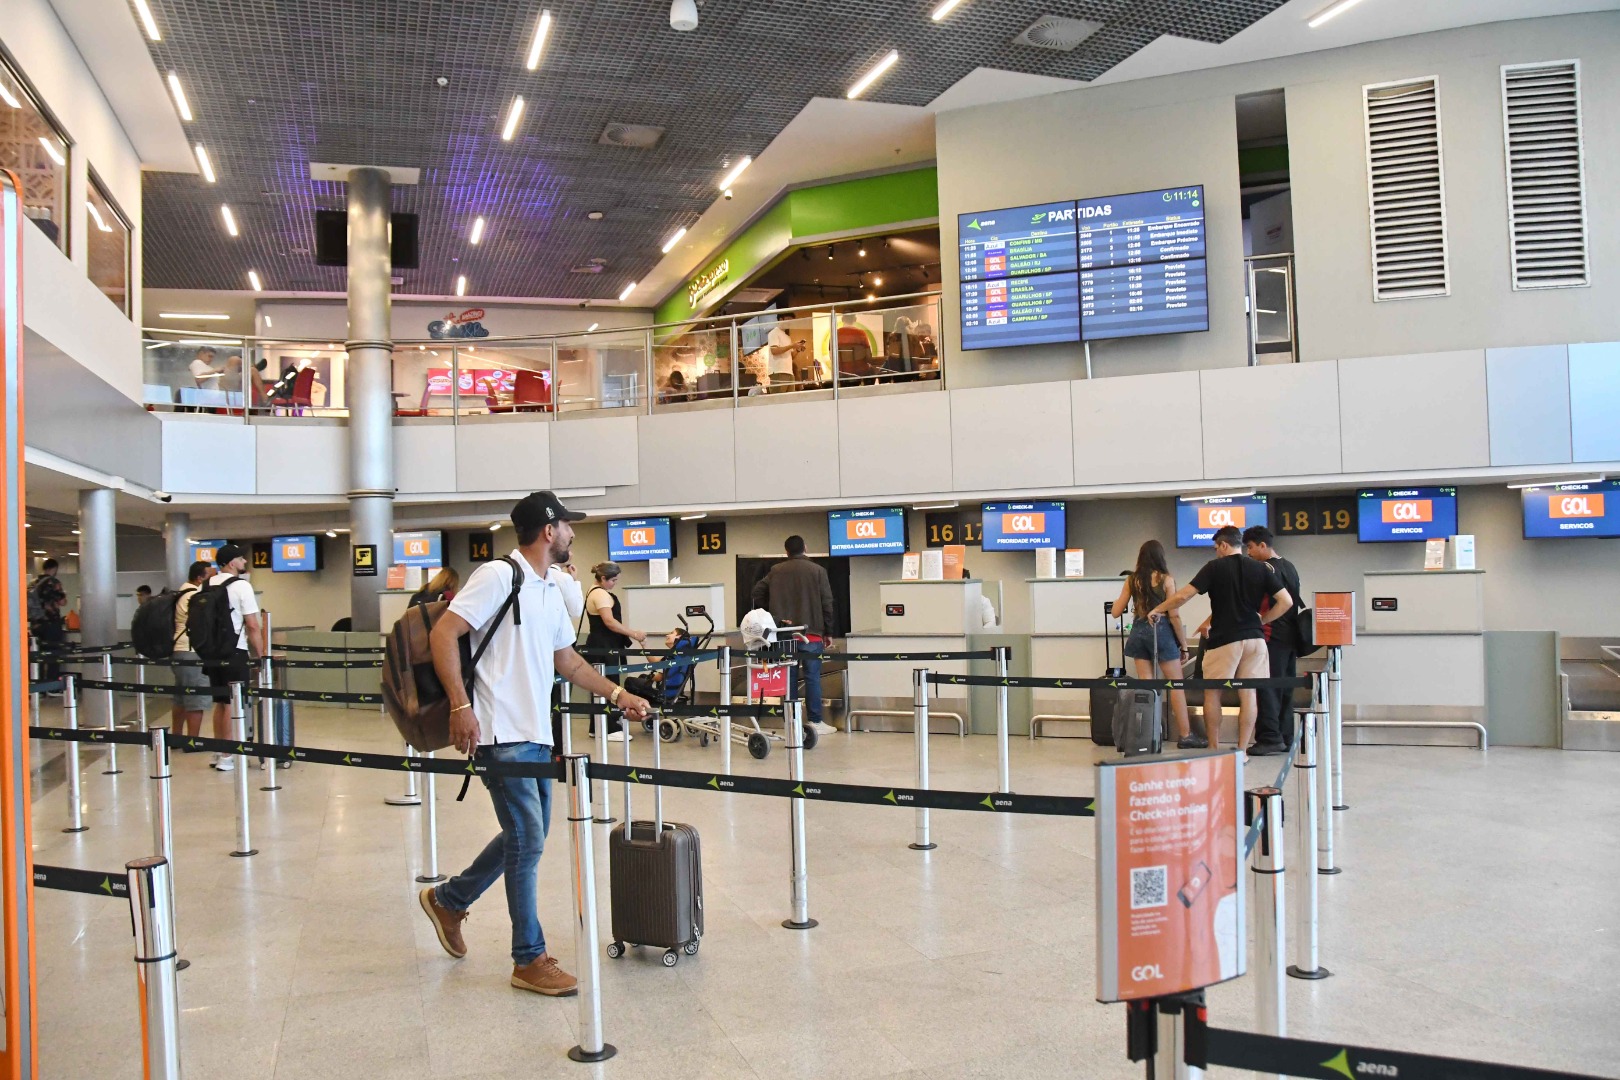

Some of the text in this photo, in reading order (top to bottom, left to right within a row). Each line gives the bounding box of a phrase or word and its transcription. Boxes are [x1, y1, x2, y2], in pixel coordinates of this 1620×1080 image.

[1174, 190, 1198, 200] 11:14
[1048, 204, 1112, 222] PARTIDAS
[1012, 300, 1042, 308] GUARULHOS
[1393, 503, 1420, 520] GOL
[1561, 497, 1592, 515] GOL
[1012, 516, 1035, 531] GOL
[1209, 510, 1234, 526] GOL
[1282, 511, 1308, 530] 18
[1322, 510, 1350, 529] 19
[856, 522, 877, 536] GOL
[931, 524, 953, 542] 16
[630, 531, 648, 544] GOL
[702, 534, 720, 550] 15
[200, 549, 212, 560] GOL
[287, 546, 300, 557] GOL
[410, 542, 424, 554] GOL
[472, 543, 489, 558] 14
[254, 552, 267, 565] 12
[1129, 777, 1197, 792] Ganhe tempo
[1130, 794, 1172, 806] fazendo
[1130, 806, 1176, 821] Check-in
[112, 882, 126, 891] aena
[1131, 964, 1164, 981] GOL
[1356, 1060, 1398, 1077] aena
